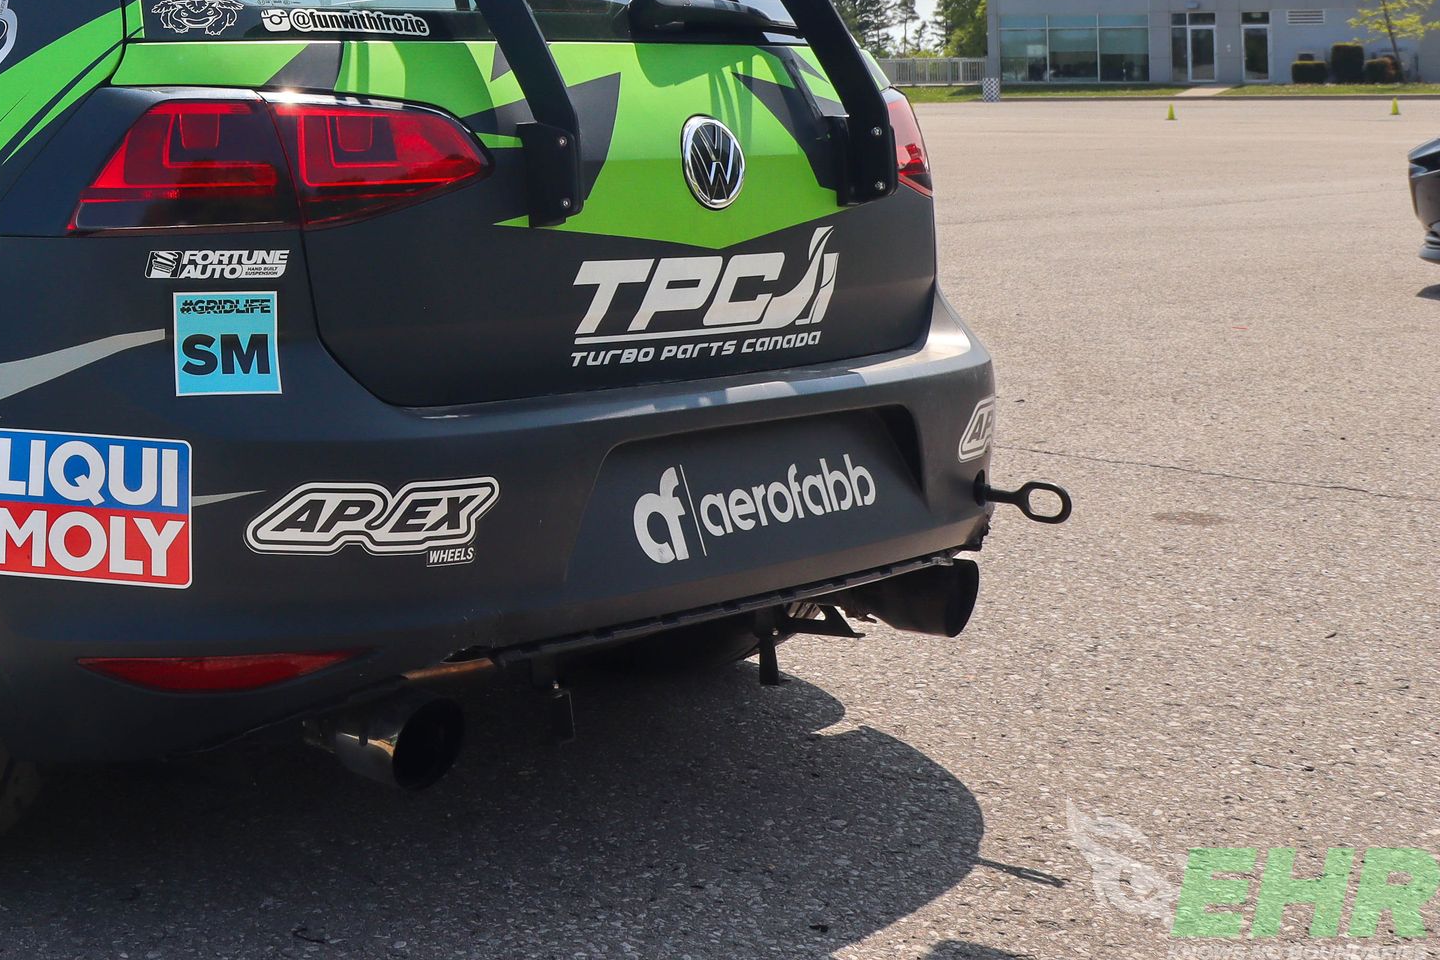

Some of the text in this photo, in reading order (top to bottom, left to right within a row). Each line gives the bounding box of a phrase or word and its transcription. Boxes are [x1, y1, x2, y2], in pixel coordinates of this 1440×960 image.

[294, 10, 428, 34] @funwithfrozie
[183, 250, 290, 264] FORTUNE
[179, 264, 243, 279] AUTO
[180, 299, 271, 315] #GRIDLIFE
[182, 333, 271, 376] SM
[700, 453, 876, 536] aerofabb
[271, 493, 480, 534] APEX
[428, 546, 475, 565] WHEELS
